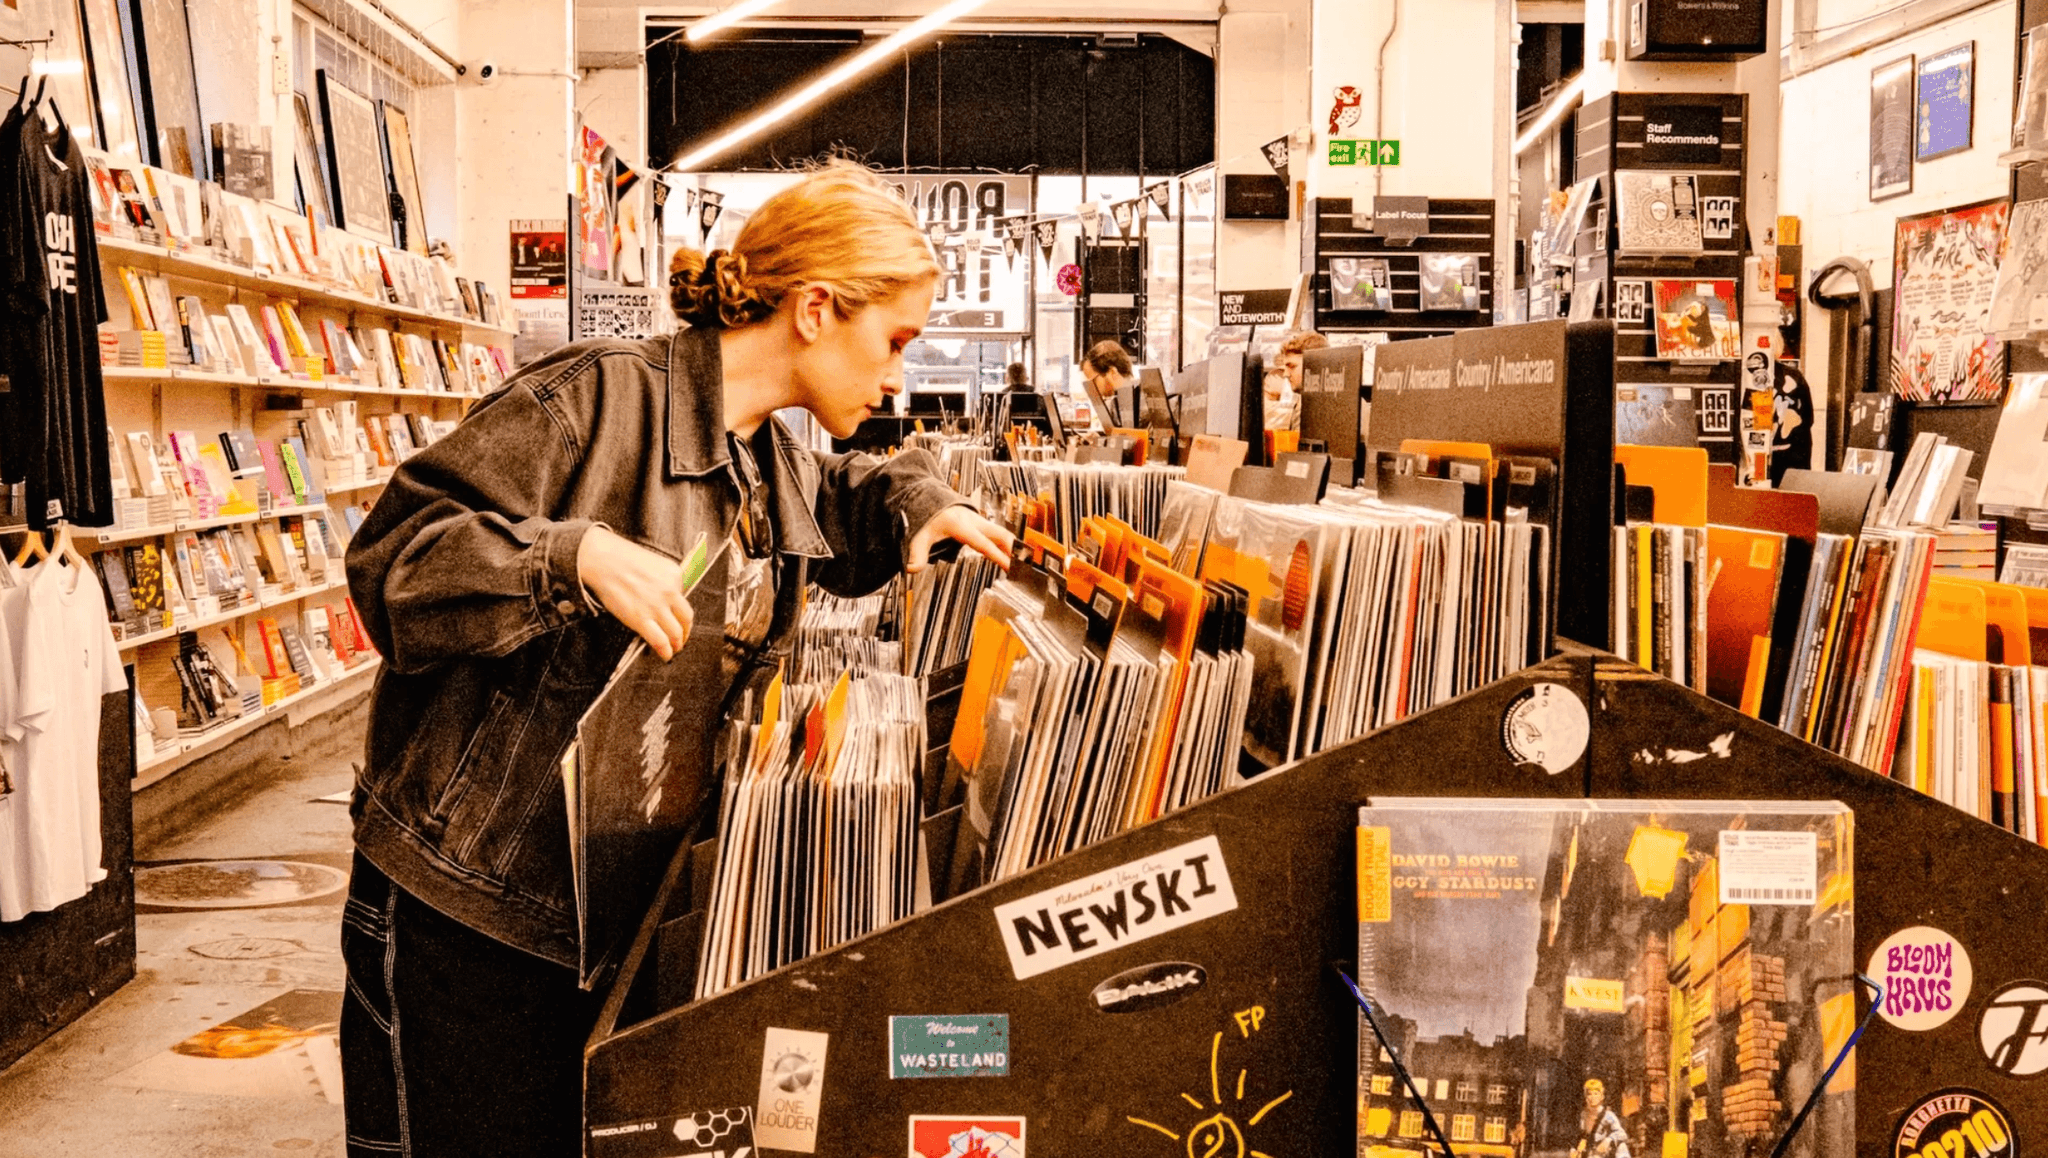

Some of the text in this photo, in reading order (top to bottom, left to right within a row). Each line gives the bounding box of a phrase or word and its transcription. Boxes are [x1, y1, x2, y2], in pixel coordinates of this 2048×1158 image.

[1646, 123, 1672, 134] Staff
[1646, 134, 1719, 145] Recommends
[1330, 142, 1350, 153] Fire
[1330, 154, 1350, 163] exit
[1375, 211, 1427, 219] Label Focus
[1222, 295, 1244, 305] NEW
[1222, 304, 1242, 314] AND
[1222, 312, 1287, 325] NOTEWORTHY
[1376, 366, 1404, 395] Country
[1409, 363, 1450, 389] Americana
[1456, 359, 1491, 392] Country
[1498, 353, 1555, 385] Americana
[1392, 855, 1519, 868] DAVID BOWIE
[1364, 831, 1374, 919] ROUGH TRADE
[1392, 876, 1537, 890] GGY STARDUST
[1012, 854, 1217, 957] NEWSKI
[1887, 941, 1953, 978] BLOOM
[926, 1021, 979, 1035] Welcome
[1234, 1005, 1266, 1038] FP
[900, 1052, 1007, 1068] WASTELAND
[774, 1099, 805, 1114] ONE
[760, 1112, 815, 1132] LOUDER
[591, 1125, 639, 1138] PRODUCER
